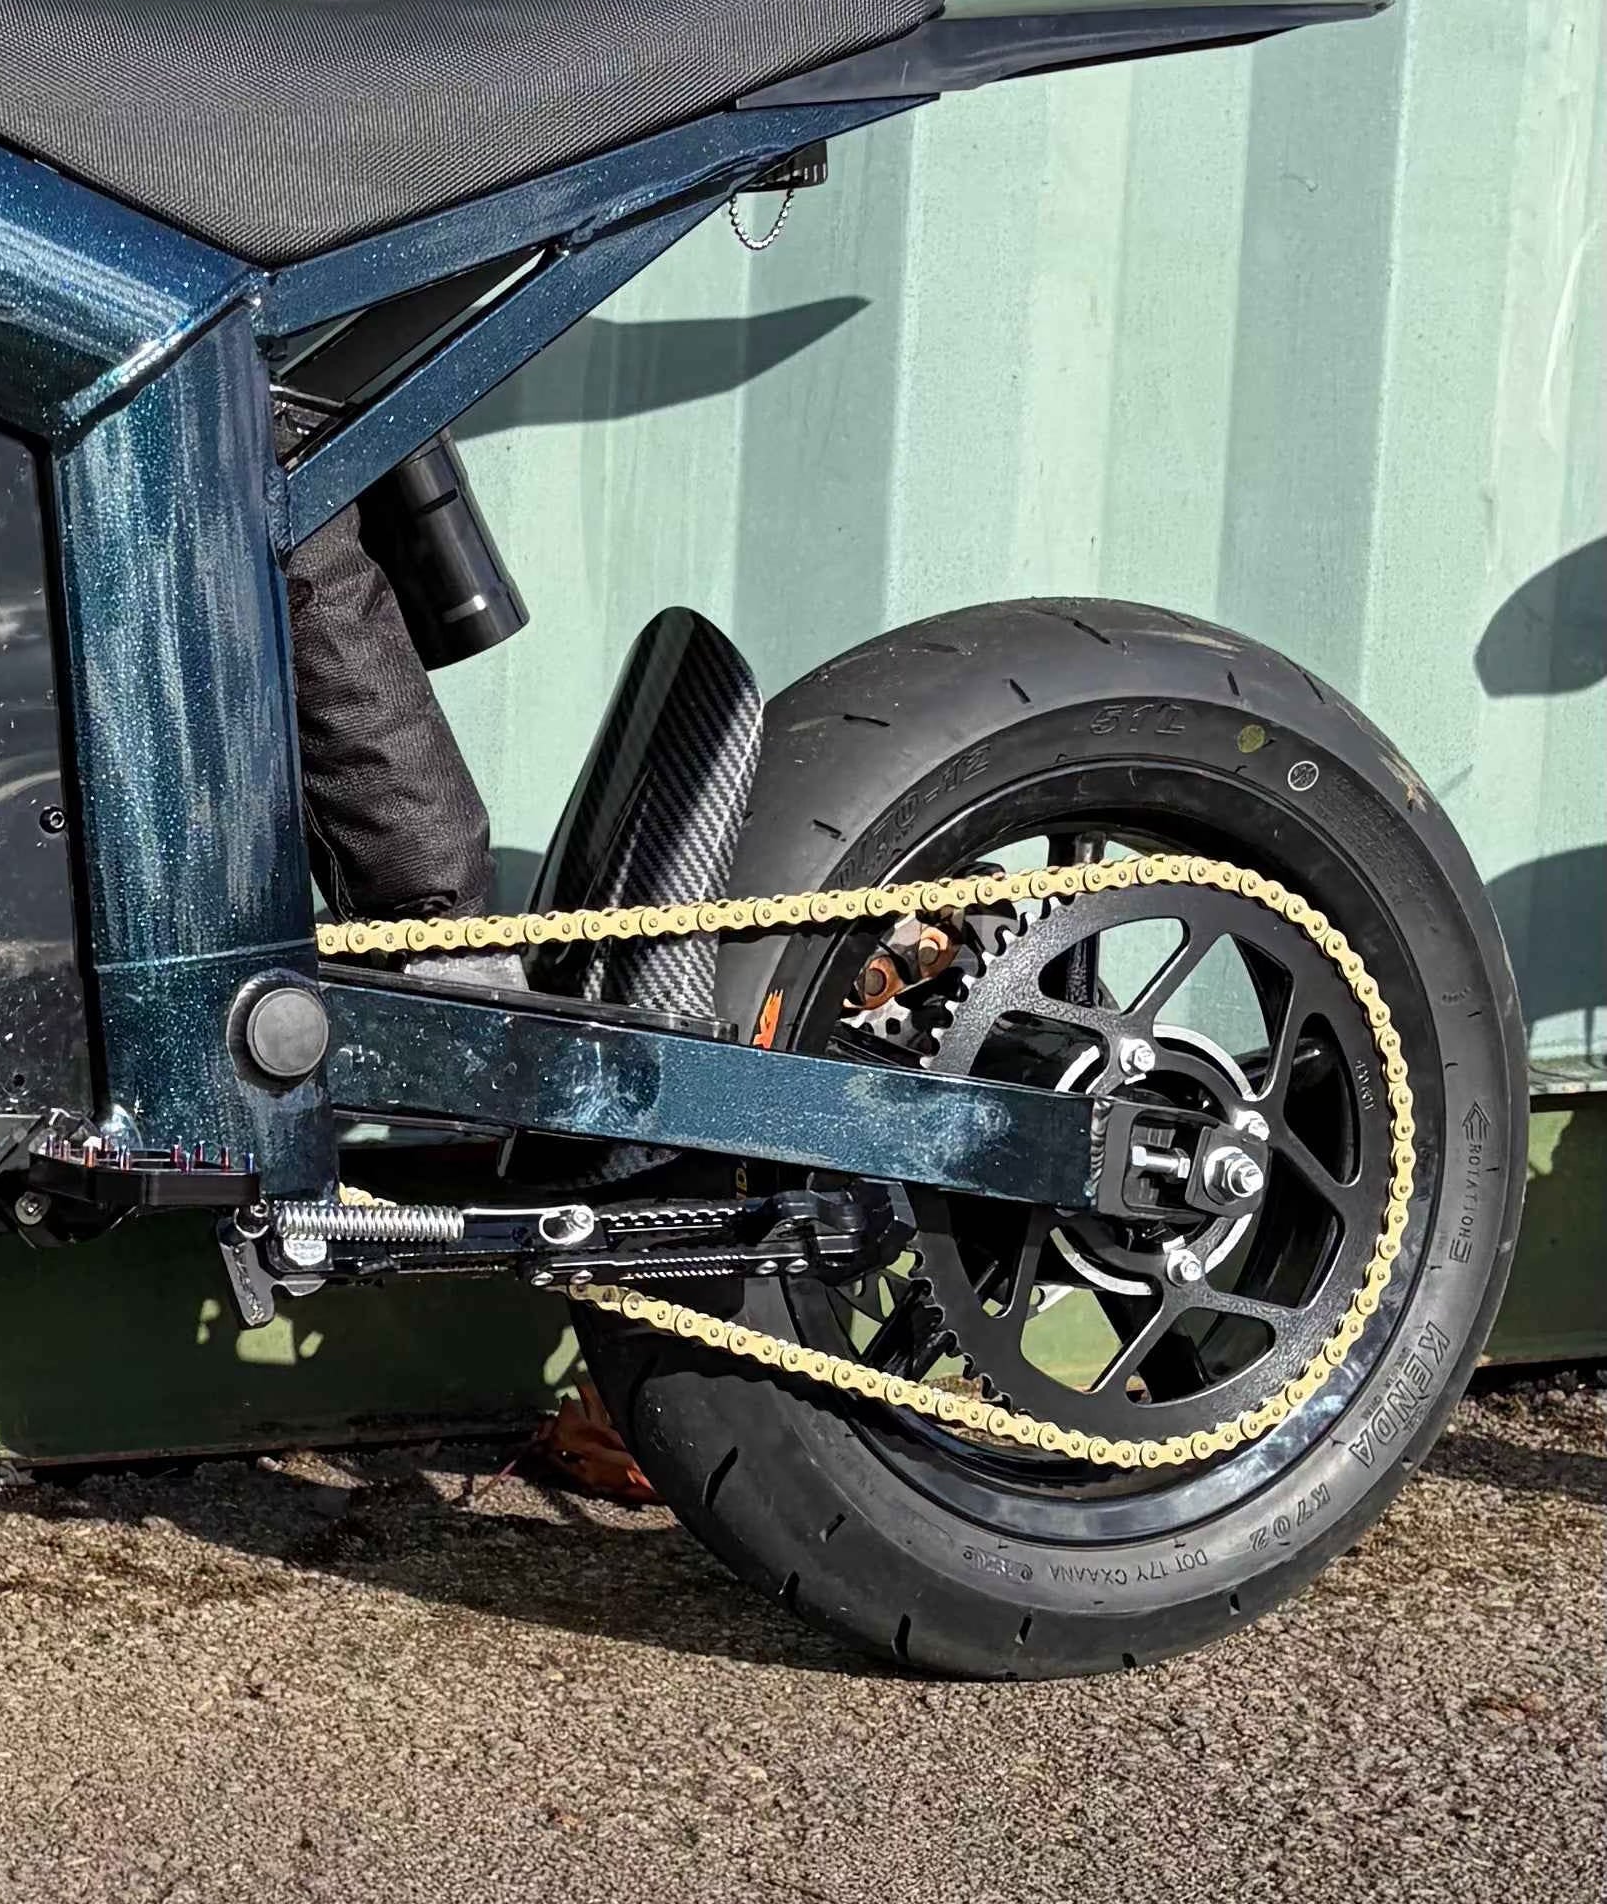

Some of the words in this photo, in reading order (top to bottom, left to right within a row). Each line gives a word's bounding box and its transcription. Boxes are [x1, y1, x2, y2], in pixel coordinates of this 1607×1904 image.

[1458, 1143, 1483, 1239] ROTATION
[1348, 1320, 1450, 1468] KENDA
[1249, 1482, 1331, 1552] K702
[1049, 1563, 1128, 1585] CXAANA
[1136, 1563, 1170, 1583] 17Y
[1174, 1549, 1209, 1568] DOT
